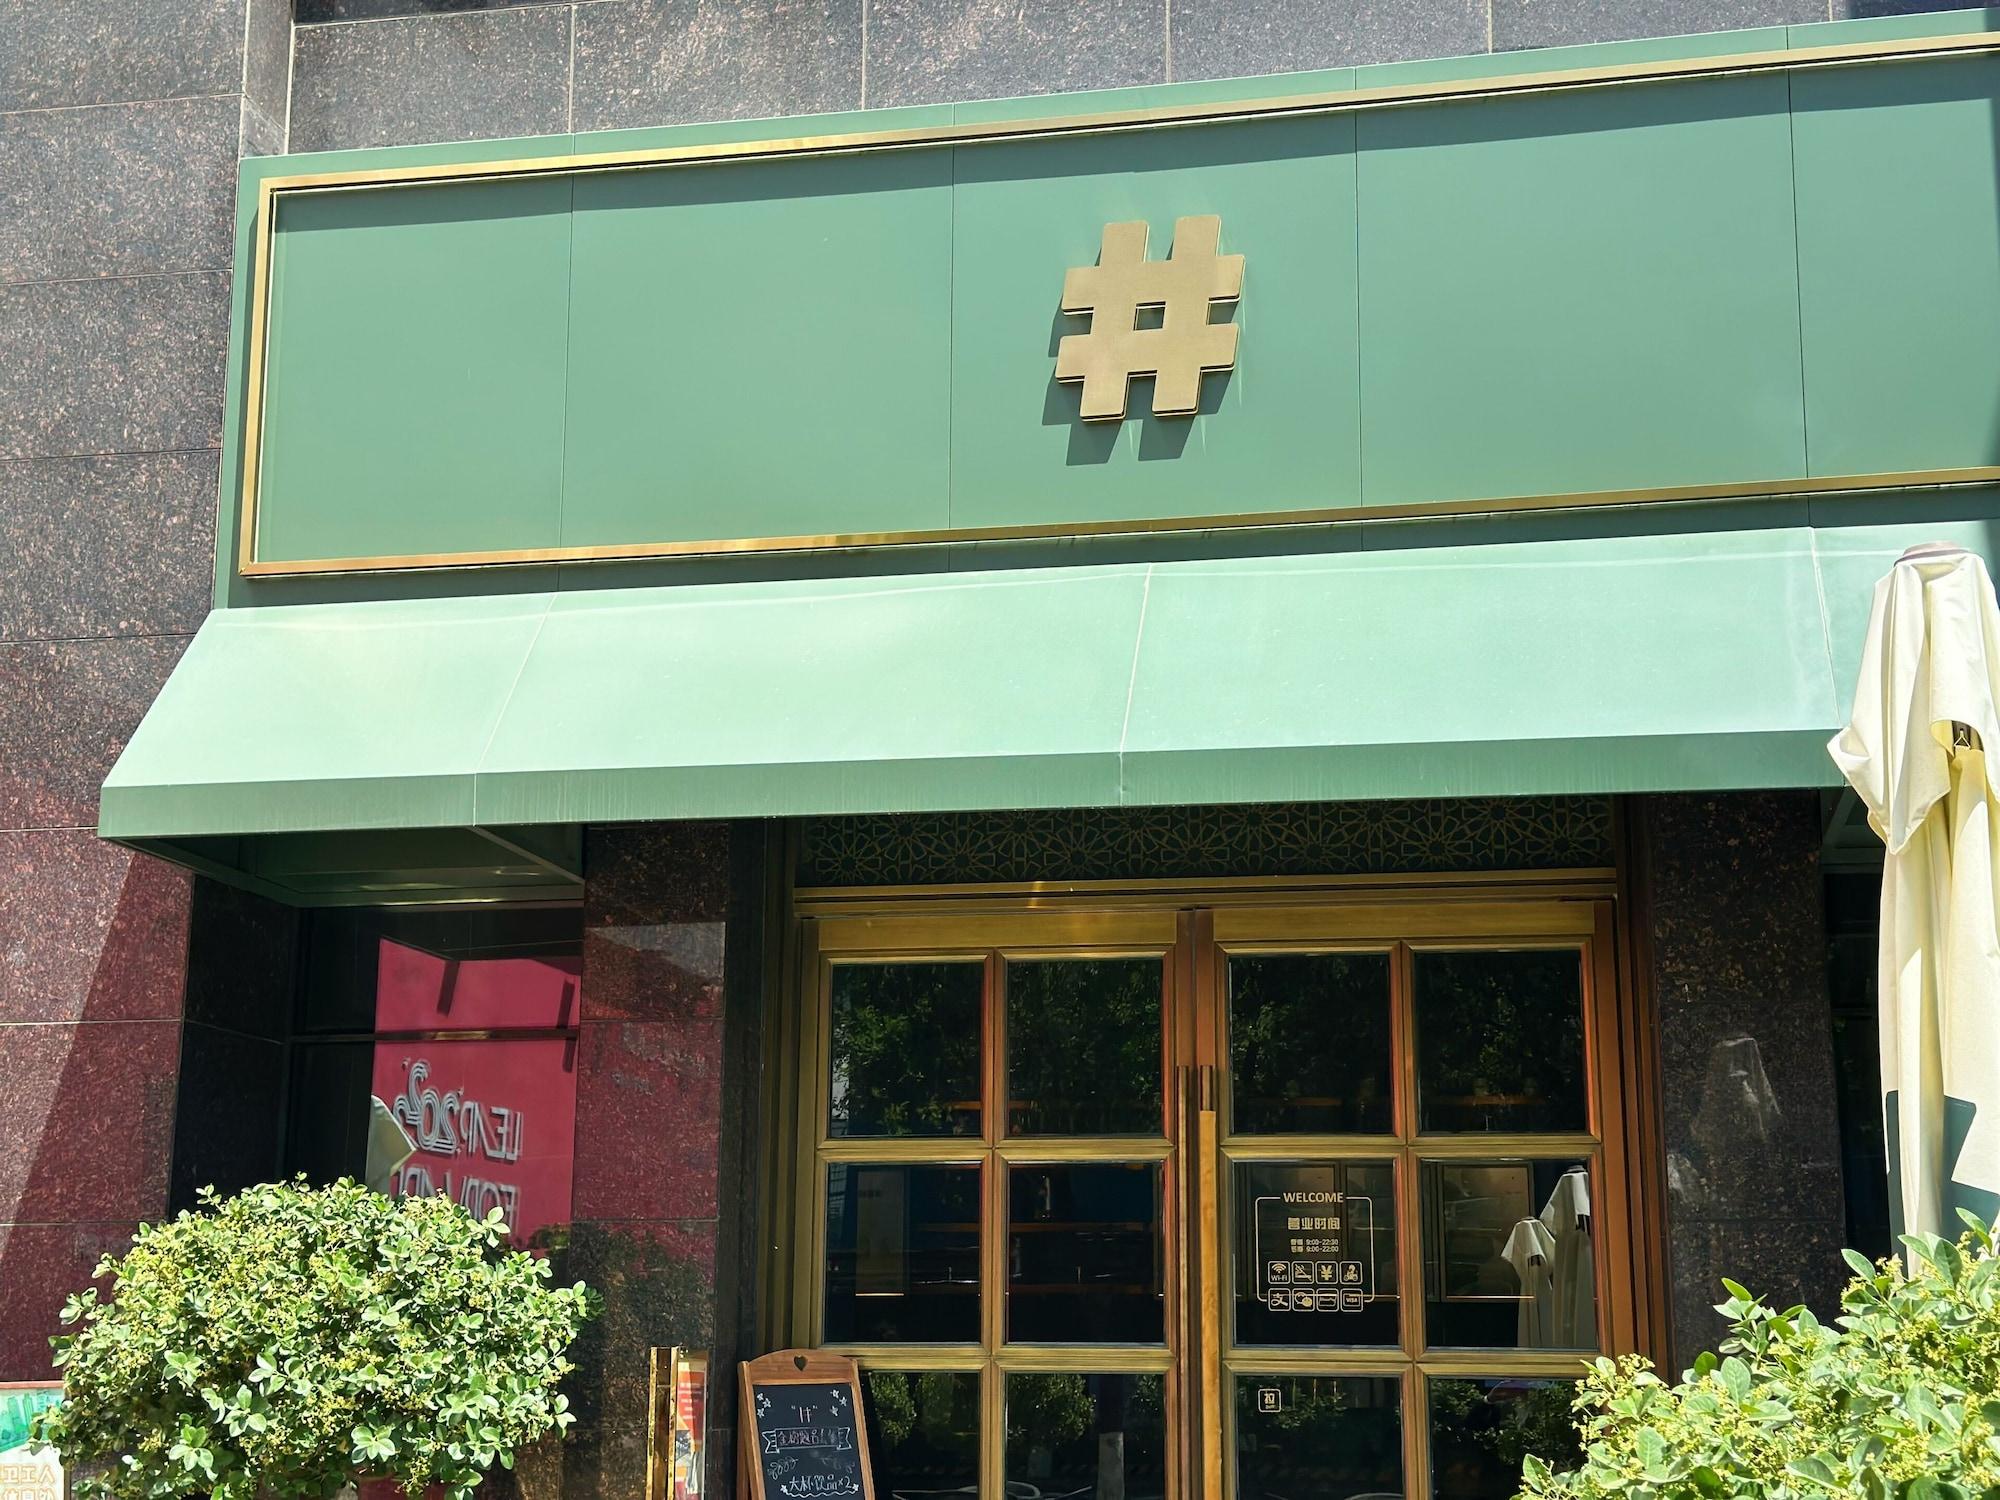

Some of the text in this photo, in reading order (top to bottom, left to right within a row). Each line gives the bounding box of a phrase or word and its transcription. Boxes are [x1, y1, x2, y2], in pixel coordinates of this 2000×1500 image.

[1283, 1192, 1344, 1203] WELCOME
[1287, 1217, 1341, 1230] 营业时间
[0, 1464, 55, 1483] 卫工人
